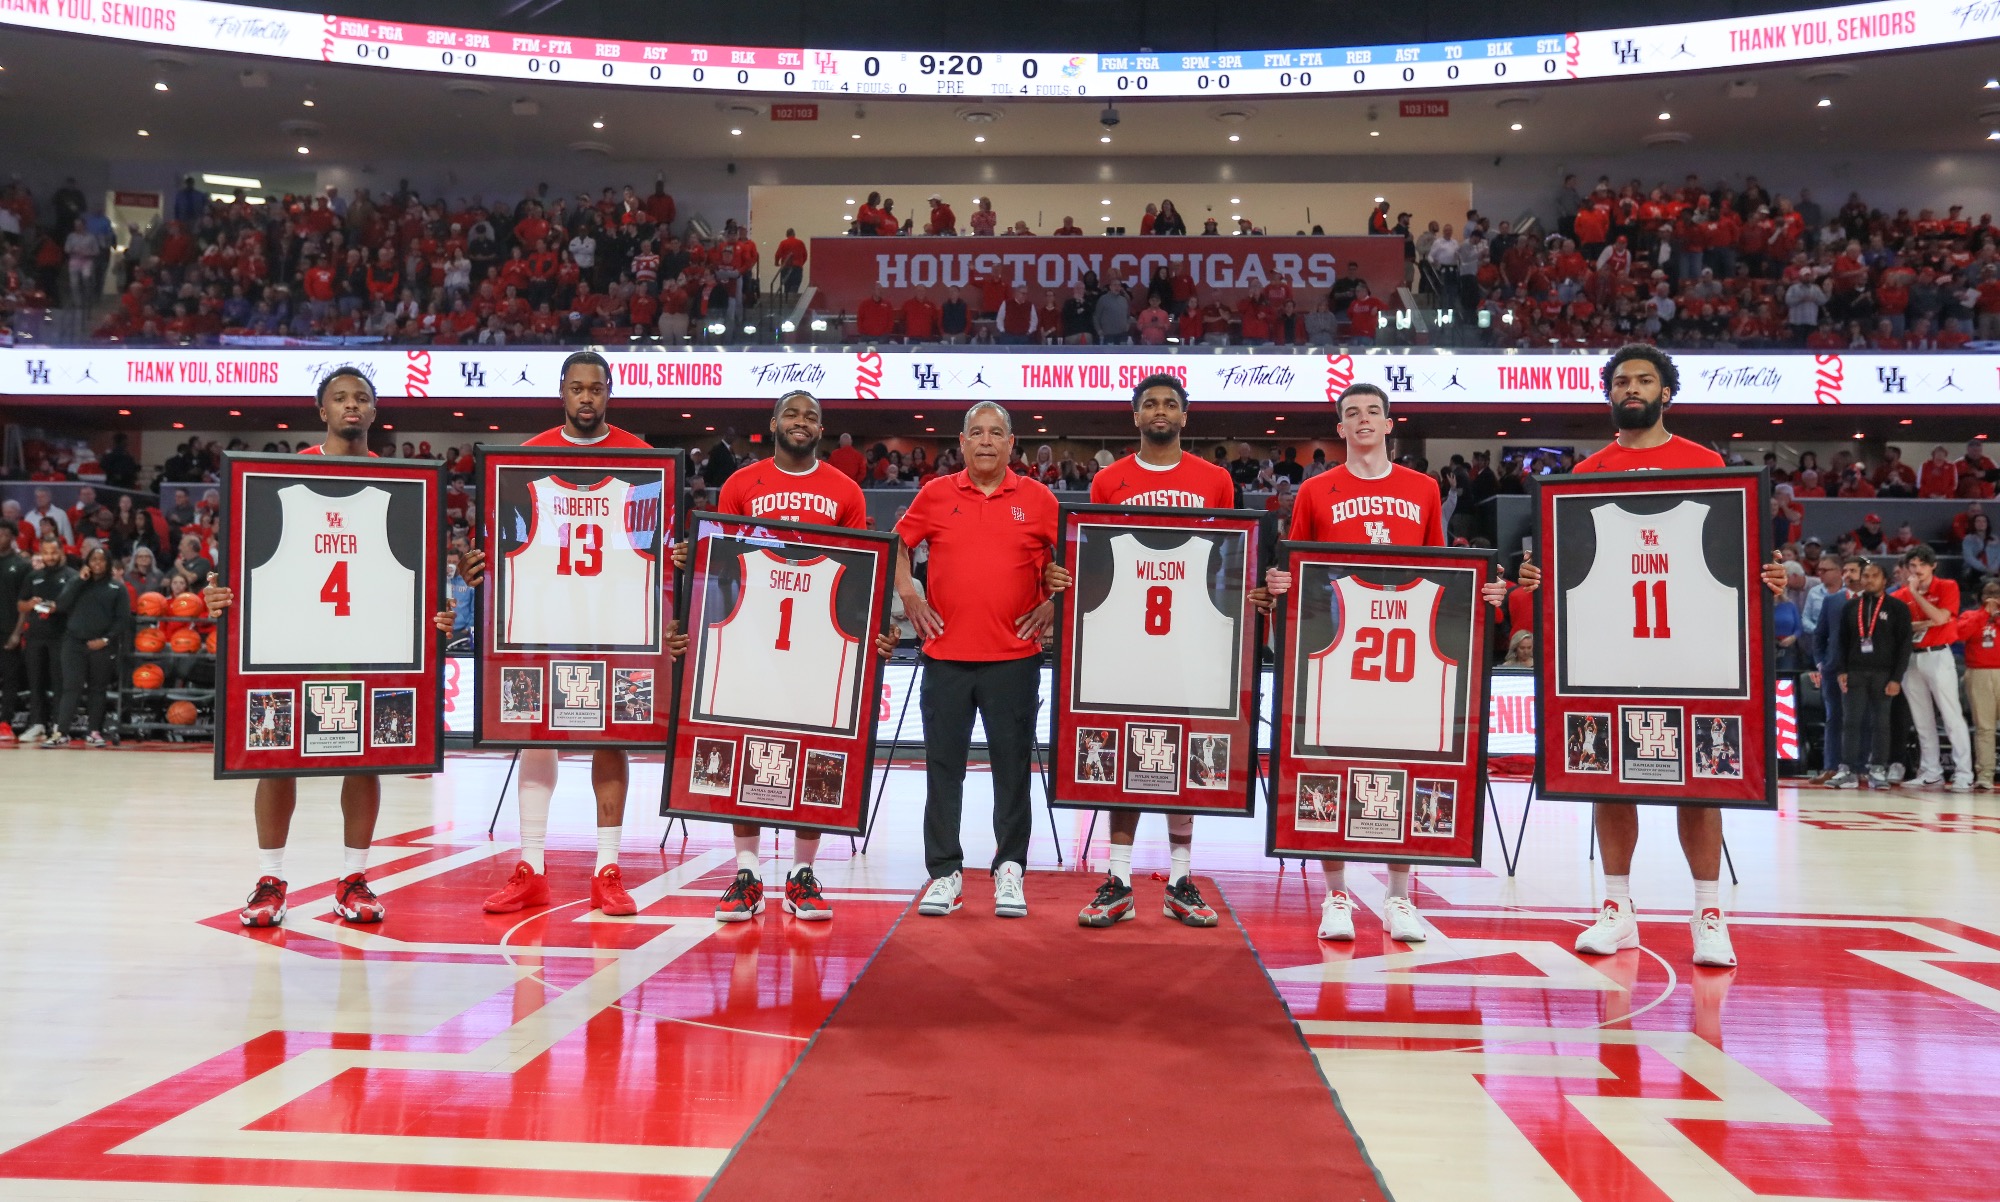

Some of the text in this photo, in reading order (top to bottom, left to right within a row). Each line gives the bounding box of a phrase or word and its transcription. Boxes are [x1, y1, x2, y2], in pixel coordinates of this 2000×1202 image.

[101, 1, 176, 32] SENIORS
[1729, 10, 1916, 52] THANK YOU, SENIORS
[595, 43, 620, 58] REB
[643, 46, 668, 61] AST
[691, 49, 708, 62] TO
[1346, 50, 1372, 64] REB
[1395, 48, 1420, 62] AST
[1445, 45, 1462, 60] TO
[1487, 42, 1513, 57] BLK
[1537, 39, 1561, 54] STL
[731, 51, 755, 64] BLK
[777, 53, 800, 66] STL
[864, 56, 880, 77] 0
[919, 55, 983, 75] 9:20
[1022, 58, 1038, 79] 0
[840, 82, 849, 92] 4
[899, 83, 907, 94] 0
[937, 81, 964, 94] PRE
[1020, 85, 1028, 95] 4
[1078, 85, 1086, 96] 0
[127, 361, 279, 386] THANK YOU, SENIORS
[618, 363, 653, 389] YOU,
[657, 363, 723, 386] SENIORS
[749, 362, 827, 388] #ForTheCity
[1022, 365, 1074, 388] THANK
[1078, 365, 1115, 391] YOU,
[1216, 365, 1296, 391] #ForTheCity
[1498, 367, 1552, 390] THANK
[1556, 367, 1595, 393] YOU,
[1700, 365, 1782, 392] #ForTheCity
[553, 496, 610, 517] ROBERTS
[751, 491, 838, 520] HOUSTON
[1331, 496, 1421, 525] HOUSTON
[314, 533, 358, 554] CRYER
[556, 522, 603, 577] 13
[1136, 559, 1185, 581] WILSON
[1631, 553, 1669, 574] DUNN
[320, 561, 351, 617] 4
[769, 569, 811, 593] SHEAD
[1144, 585, 1173, 636] 8
[1371, 599, 1407, 621] ELVIN
[1632, 580, 1671, 639] 11
[774, 597, 793, 651] 1
[1350, 626, 1416, 683] 20
